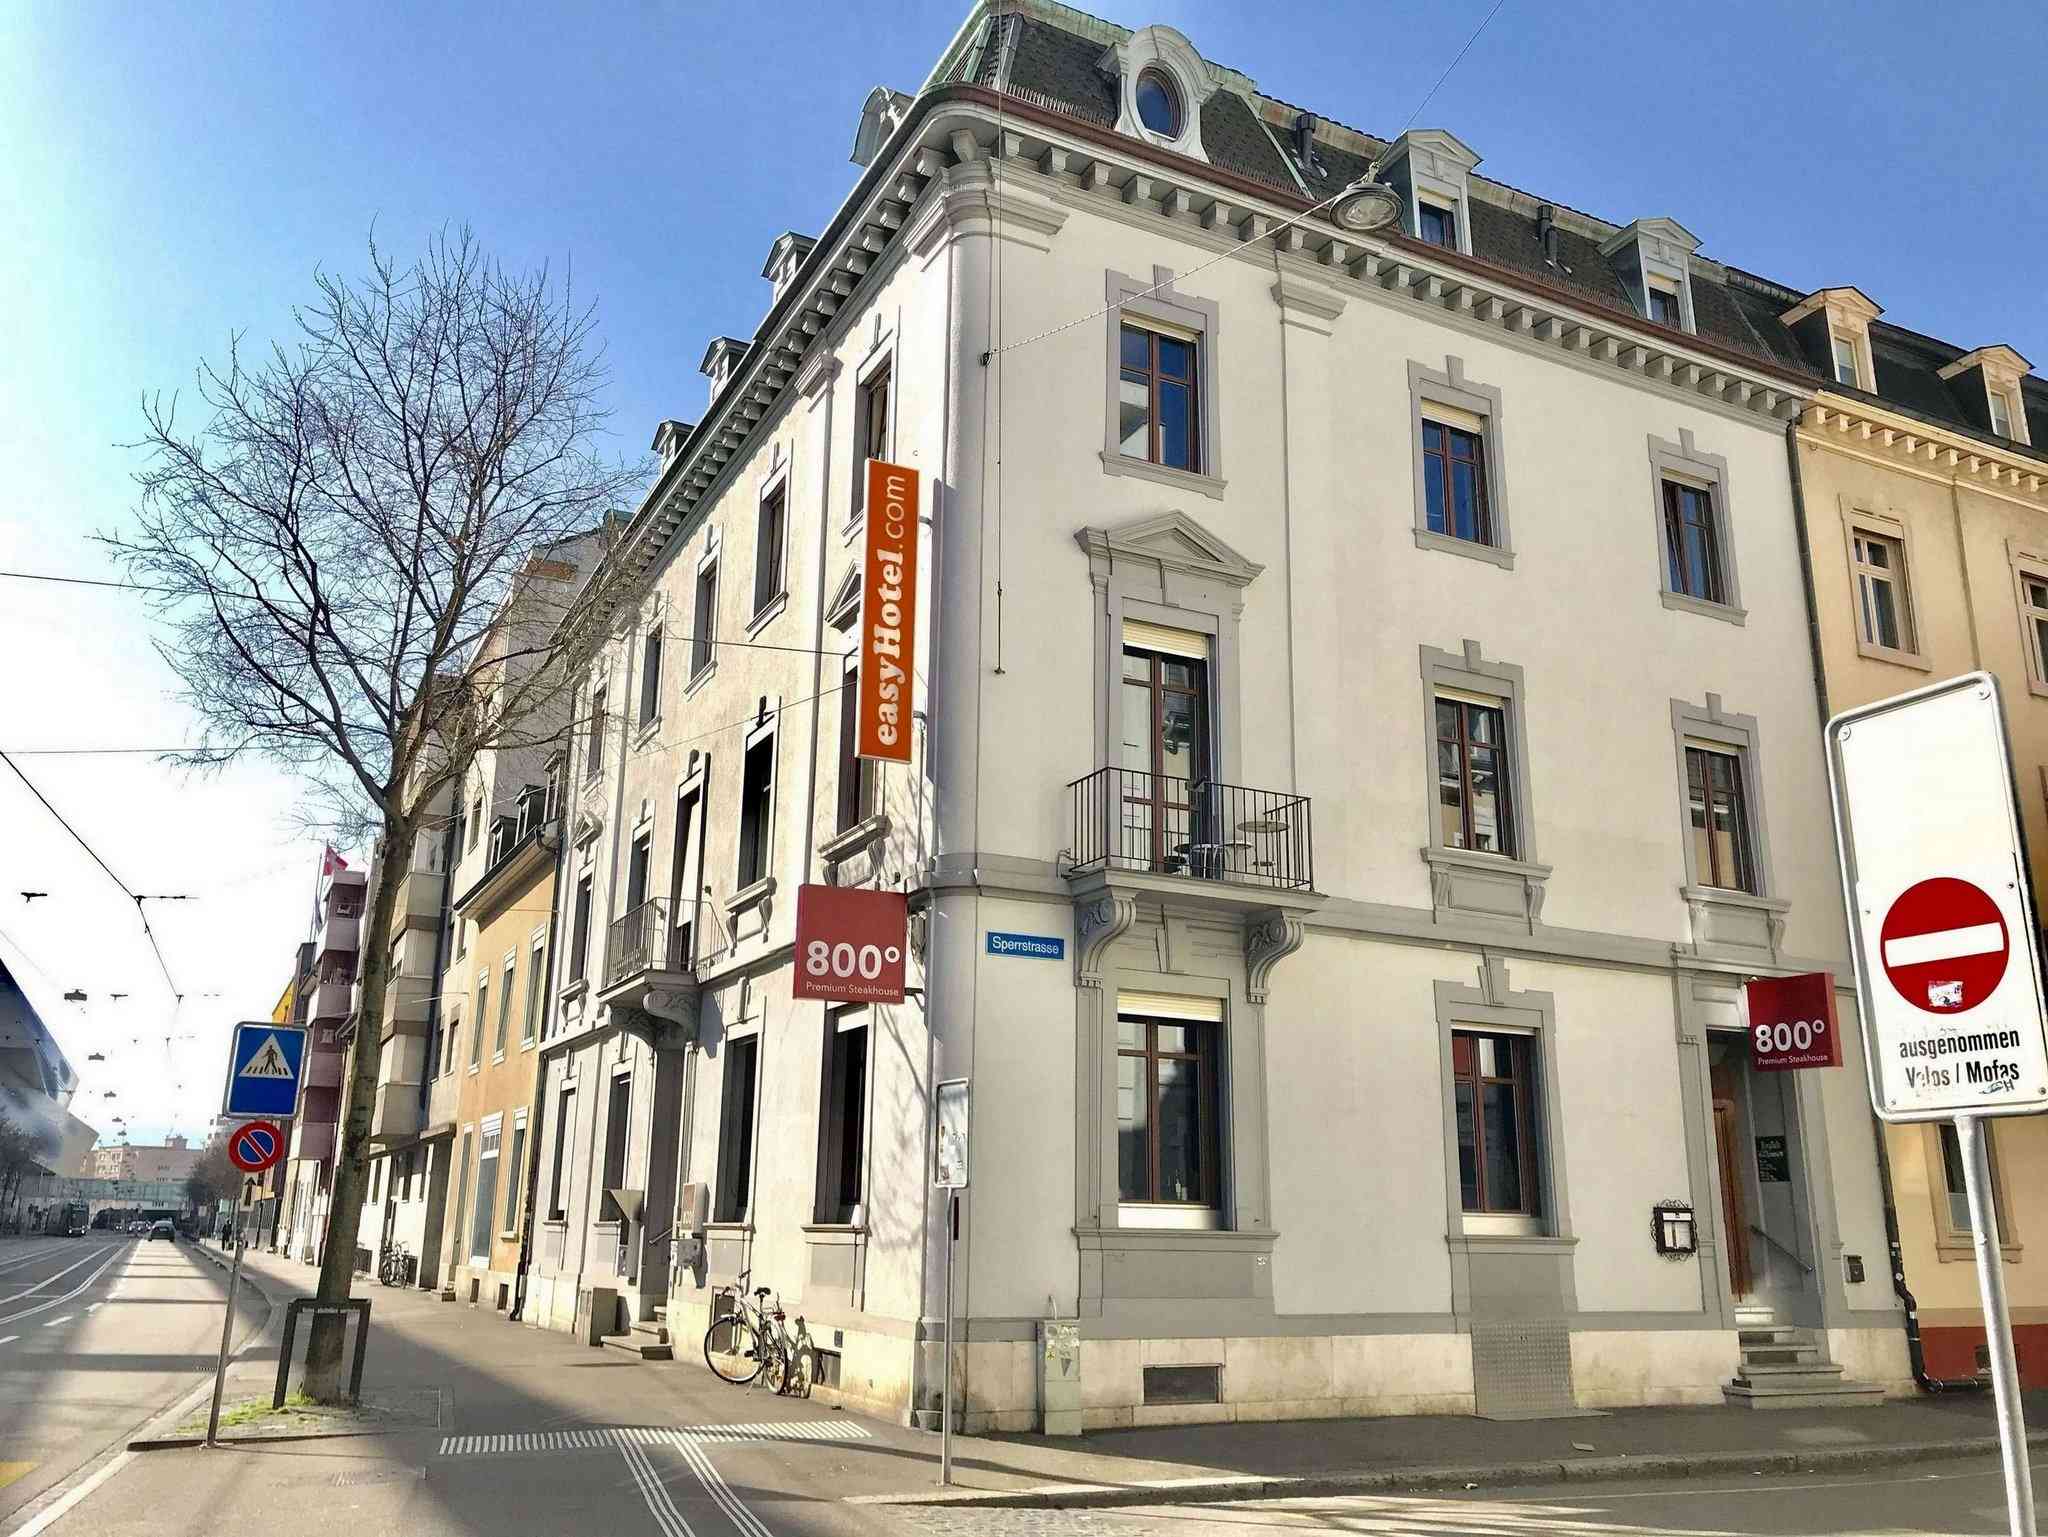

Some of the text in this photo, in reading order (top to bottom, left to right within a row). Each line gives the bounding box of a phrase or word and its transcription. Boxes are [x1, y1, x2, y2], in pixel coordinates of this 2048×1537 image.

[873, 475, 906, 746] easyHotel.com
[806, 940, 900, 980] 800°
[992, 936, 1060, 954] Sperrstrasse
[806, 981, 899, 997] Premium Steakhouse
[1755, 1019, 1825, 1053] 800°
[1899, 1029, 2020, 1059] ausgenommen
[1956, 1062, 1960, 1083] /
[1965, 1059, 2020, 1084] Mofas
